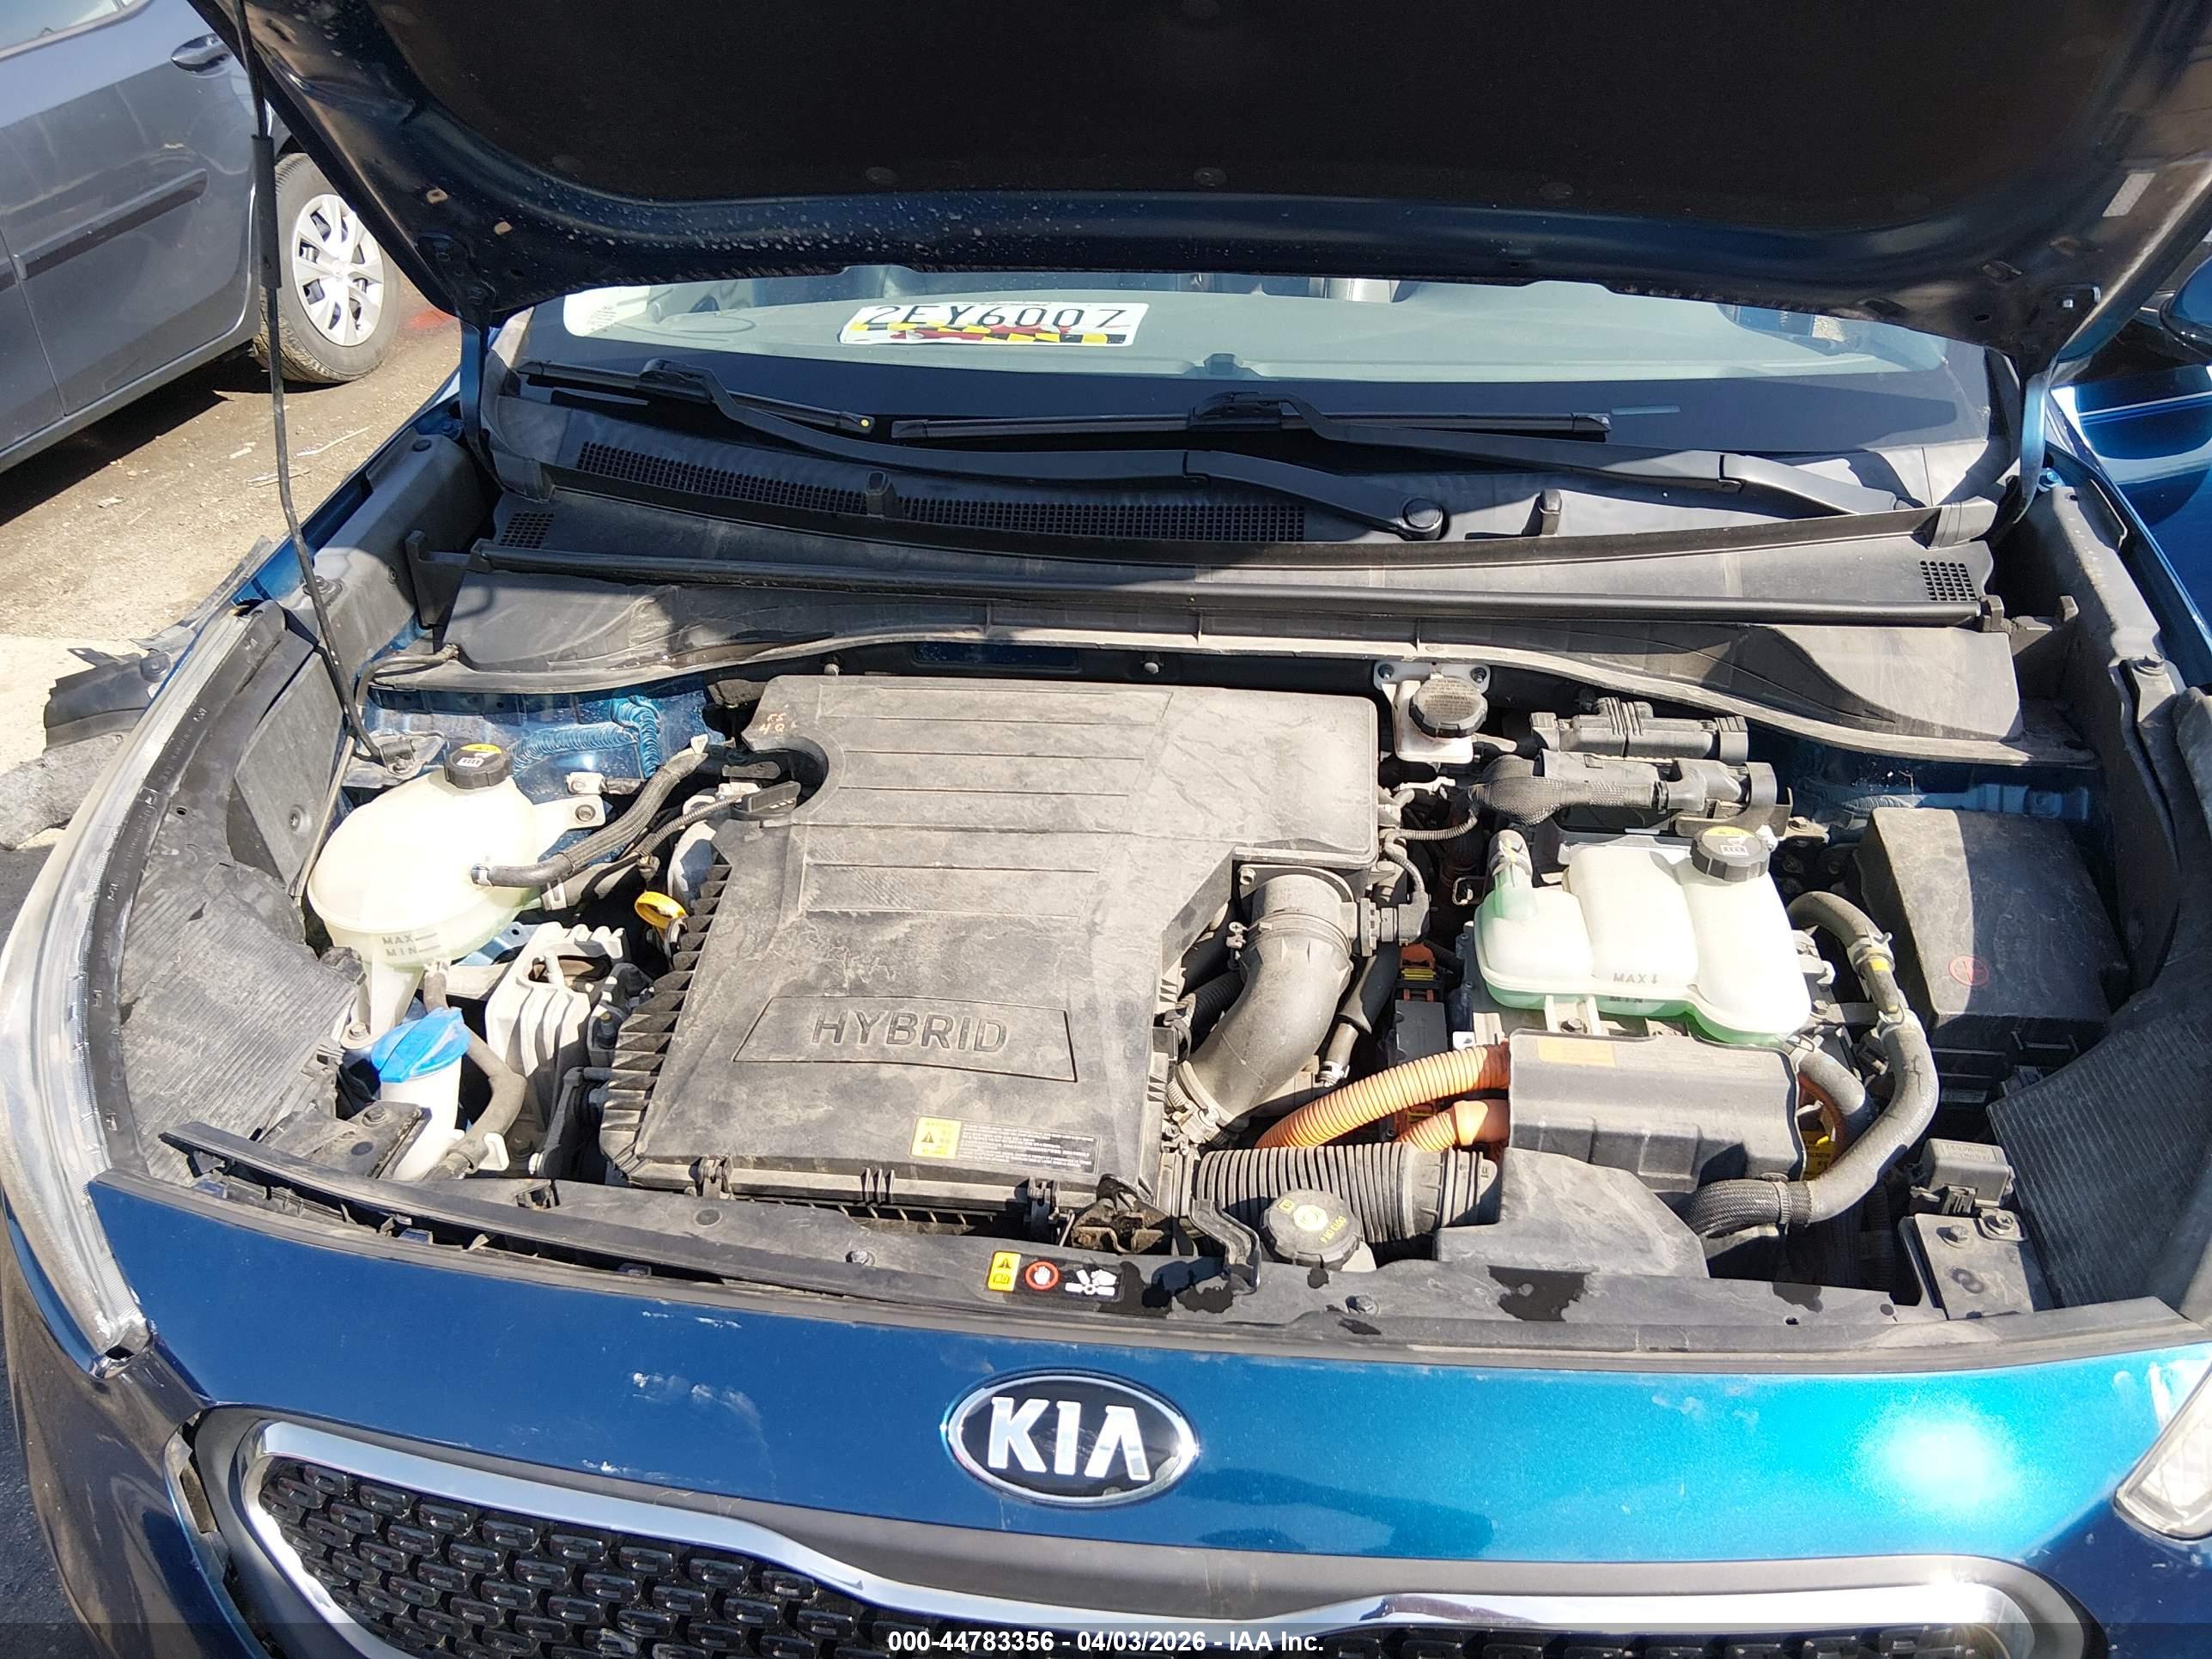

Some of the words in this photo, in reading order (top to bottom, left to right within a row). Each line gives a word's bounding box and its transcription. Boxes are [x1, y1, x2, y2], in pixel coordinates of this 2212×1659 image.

[381, 934, 413, 945] MAX
[385, 945, 417, 957] MIN
[1613, 972, 1648, 984] MAX
[811, 1010, 1008, 1053] HYBRID
[988, 1396, 1151, 1481] KIA
